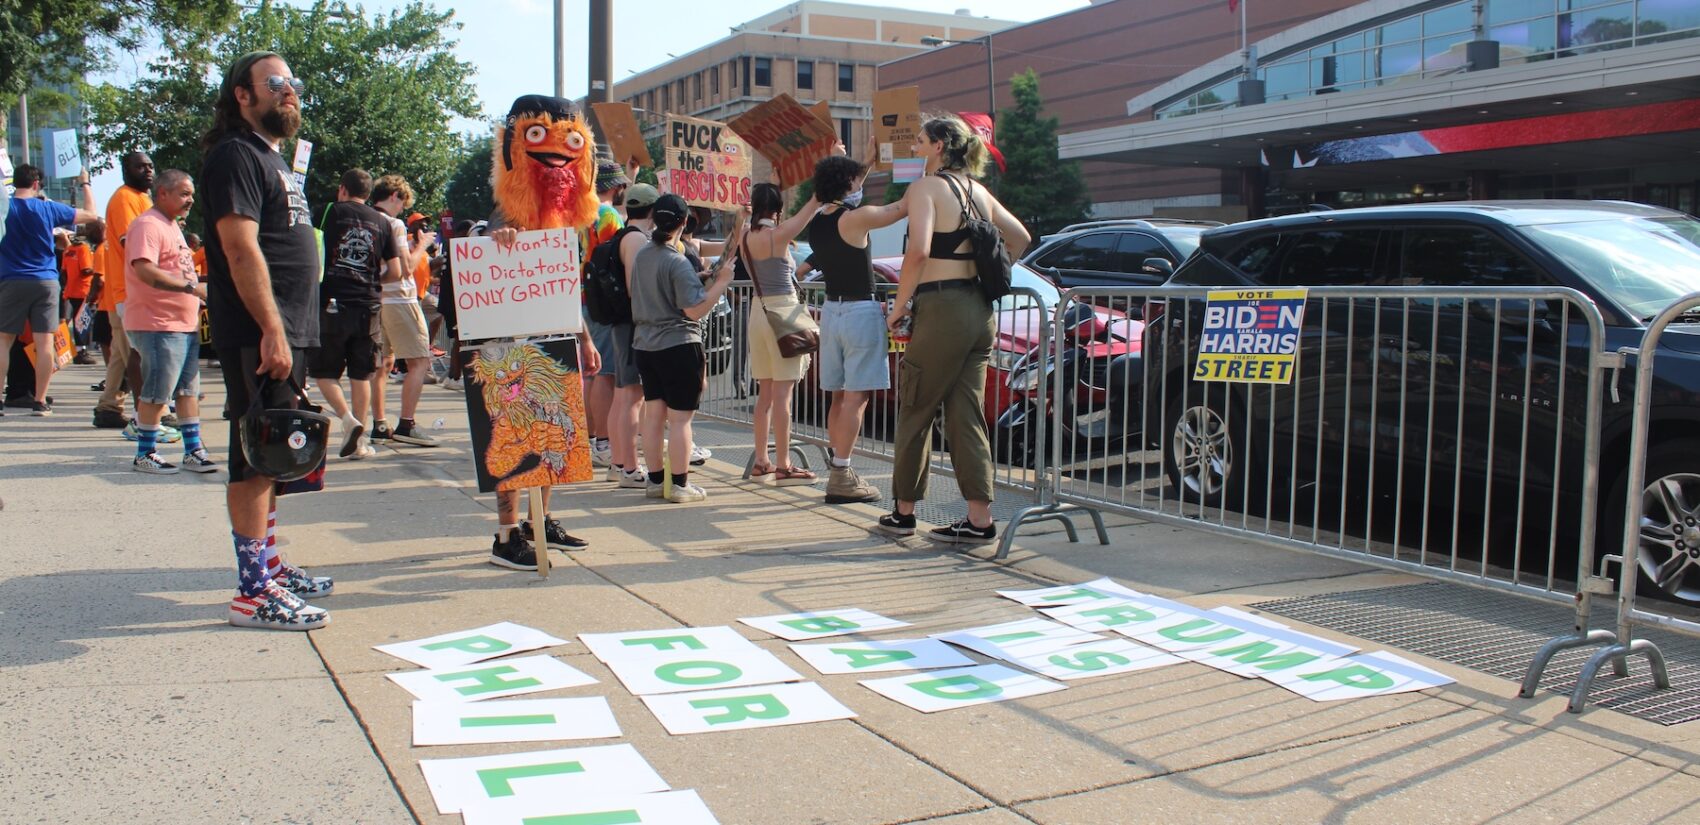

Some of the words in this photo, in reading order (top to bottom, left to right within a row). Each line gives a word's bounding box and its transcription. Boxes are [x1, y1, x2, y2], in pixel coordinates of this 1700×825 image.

[672, 121, 722, 152] FUCK
[678, 151, 704, 171] the
[671, 168, 751, 206] FASCISTS
[489, 250, 575, 281] Dictators!
[459, 287, 505, 310] ONLY
[511, 278, 578, 302] GRITTY
[1237, 291, 1274, 299] VOTE
[1205, 305, 1303, 329] BIDEN
[1200, 333, 1297, 354] HARRIS
[1196, 359, 1292, 380] STREET
[1041, 588, 1395, 690] TRUMP
[778, 615, 1004, 700] BAD
[620, 634, 791, 726] FOR
[418, 634, 643, 825] PHIL
